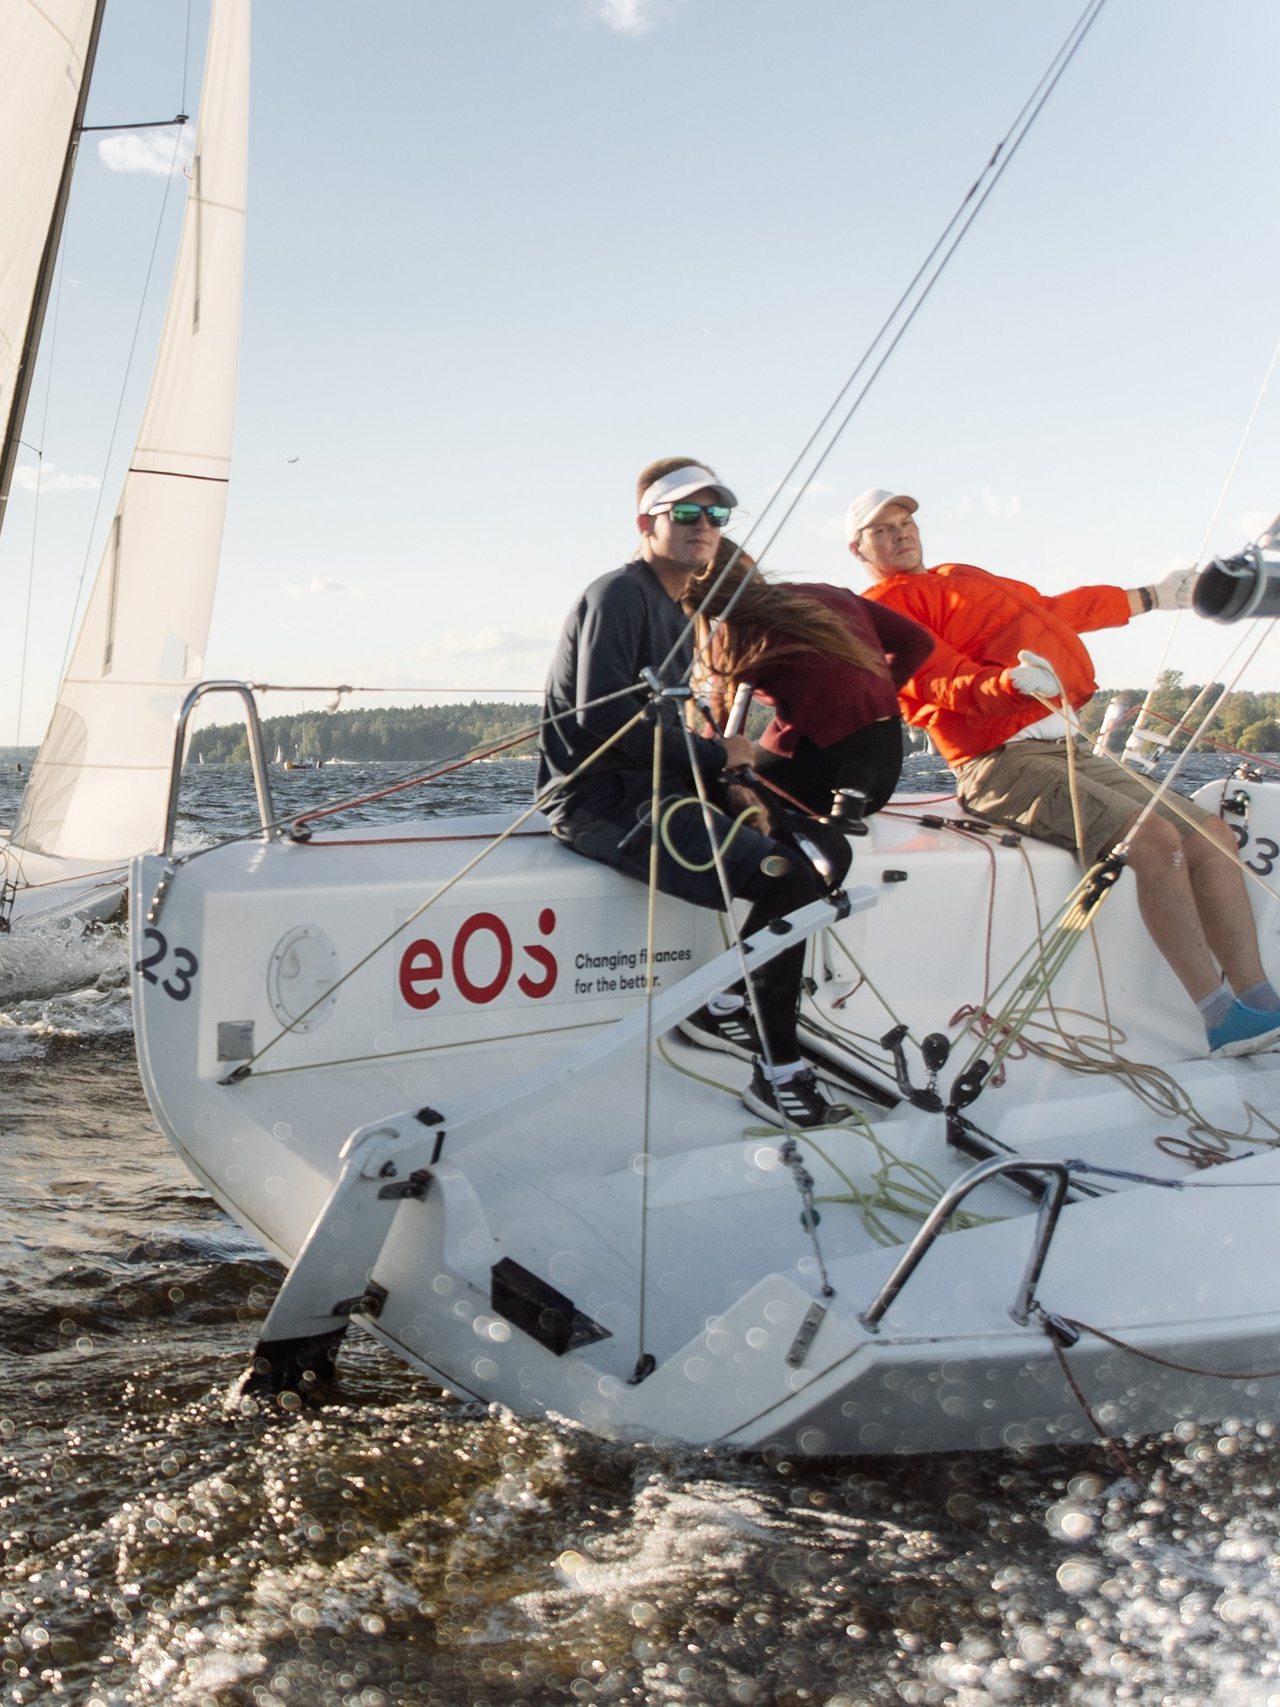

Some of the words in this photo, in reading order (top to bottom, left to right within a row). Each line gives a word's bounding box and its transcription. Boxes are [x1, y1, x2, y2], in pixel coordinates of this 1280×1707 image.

[135, 928, 199, 1002] 23
[575, 951, 636, 970] Changing
[575, 978, 593, 994] for
[596, 977, 616, 992] the
[620, 975, 661, 990] bettr.
